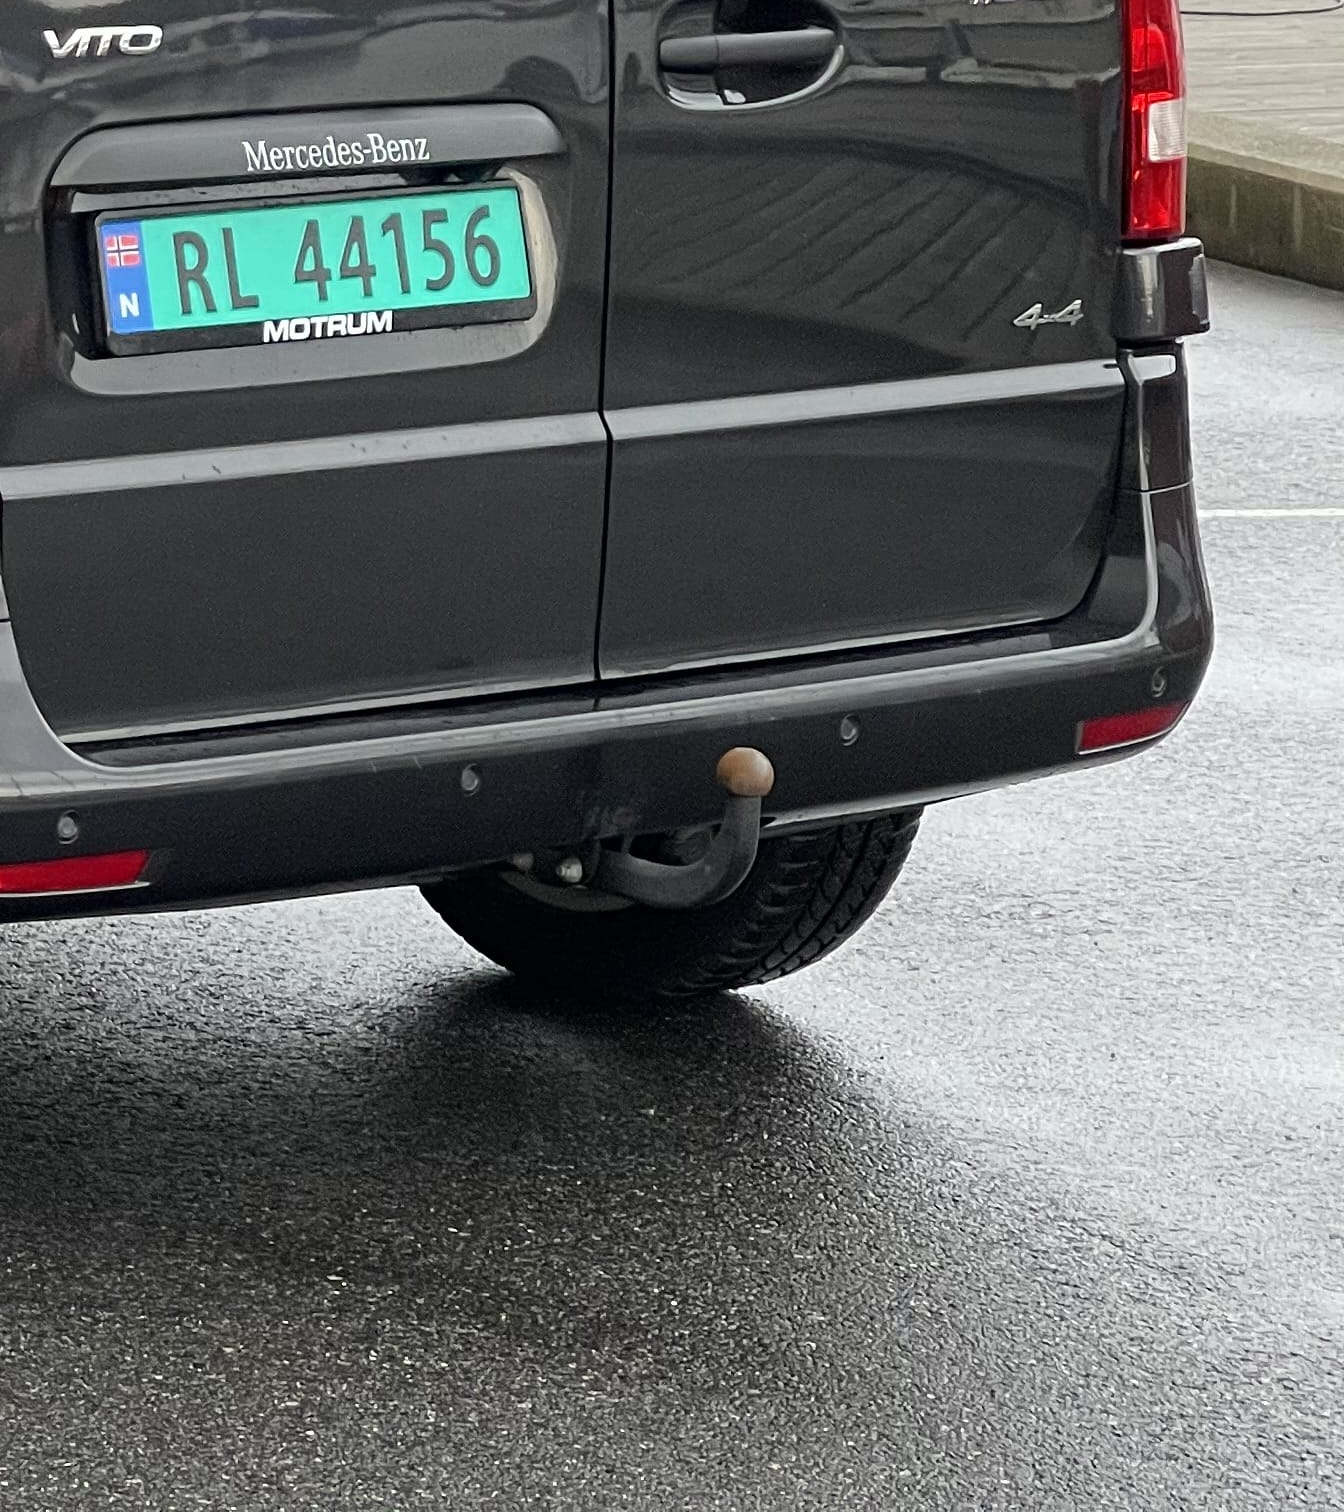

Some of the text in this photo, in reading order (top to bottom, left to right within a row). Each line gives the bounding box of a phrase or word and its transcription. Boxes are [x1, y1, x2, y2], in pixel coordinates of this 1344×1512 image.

[42, 24, 164, 59] VITO
[241, 132, 431, 172] Mercedes-Benz
[172, 204, 502, 316] RL 44156
[118, 292, 140, 319] N
[262, 309, 394, 344] MOTRUM
